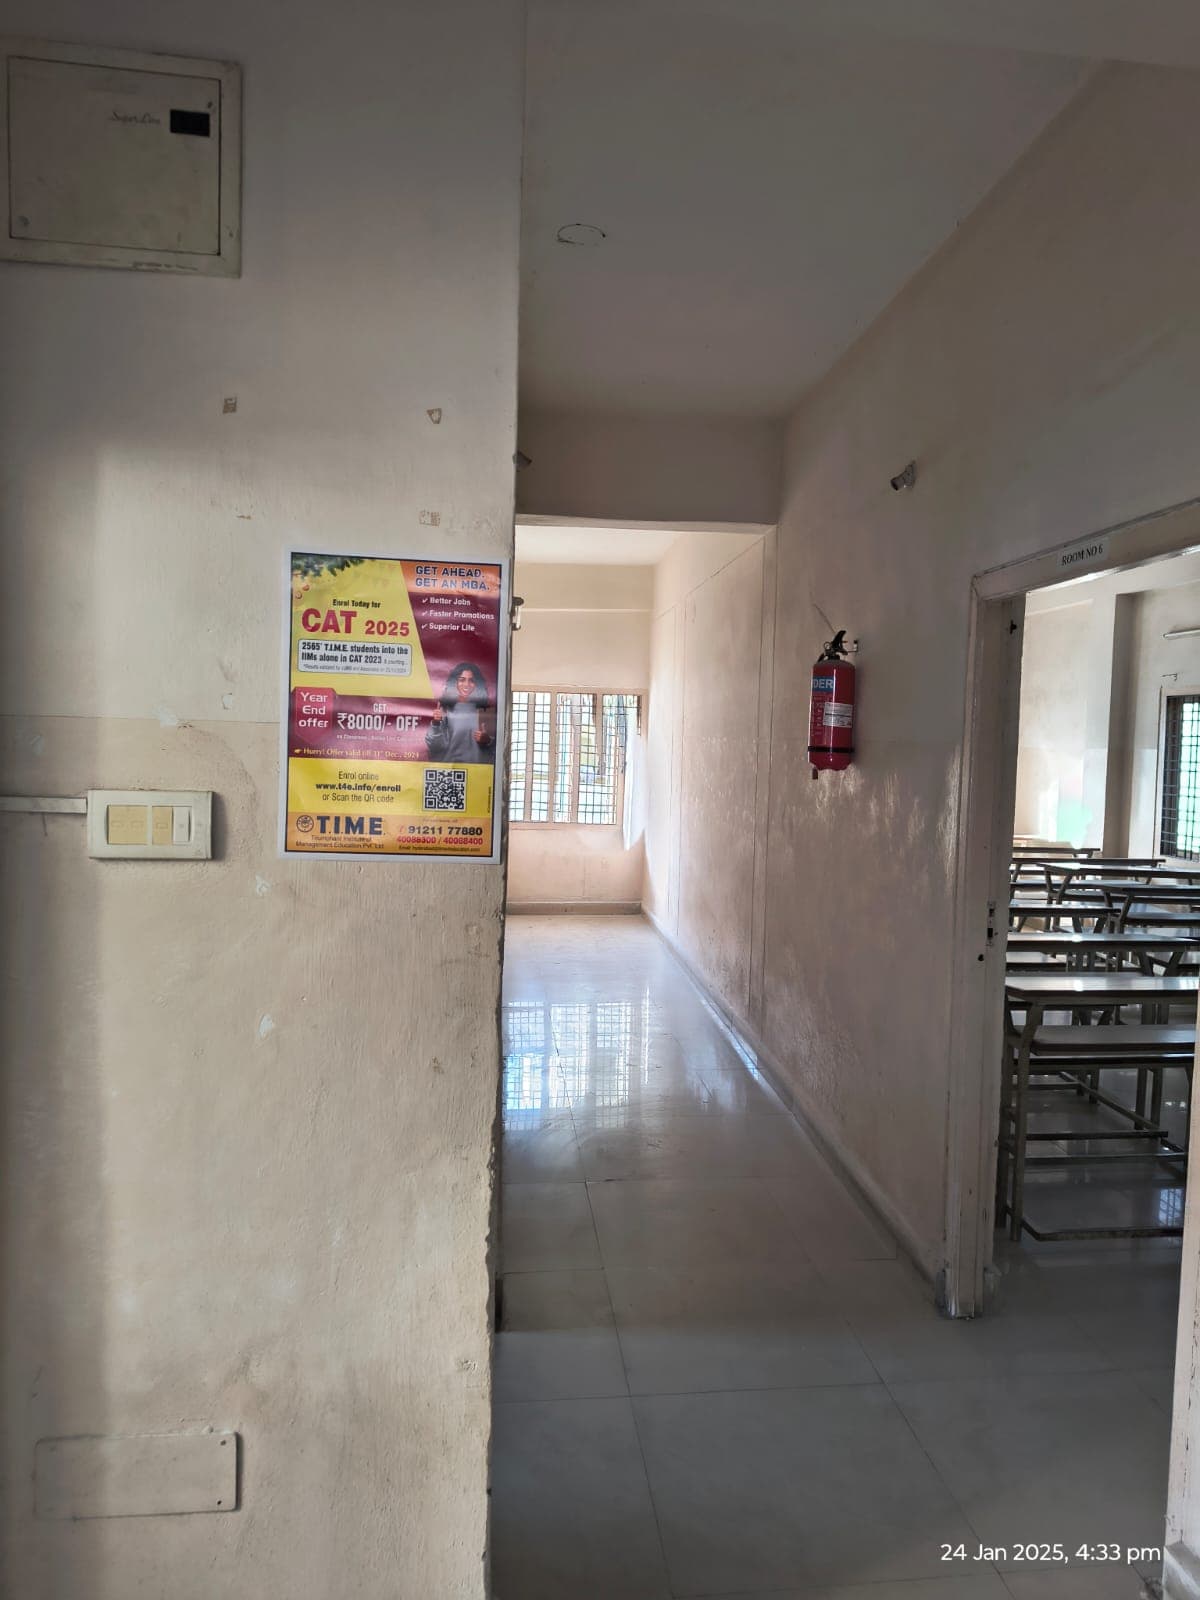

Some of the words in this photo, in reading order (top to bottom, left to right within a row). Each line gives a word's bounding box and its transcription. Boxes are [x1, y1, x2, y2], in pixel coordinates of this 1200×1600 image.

[1061, 549, 1084, 566] ROOM
[1098, 543, 1103, 554] 6
[416, 565, 437, 575] GET
[442, 567, 485, 578] AHEAD.
[415, 578, 437, 587] GET
[441, 579, 457, 588] AN
[461, 580, 490, 591] MBA.
[332, 599, 349, 607] Enrol
[352, 600, 370, 609] Today
[429, 597, 452, 605] Better
[453, 598, 471, 606] Jobs
[453, 611, 494, 620] Promotions
[301, 608, 357, 634] CAT
[365, 620, 410, 637] 2025
[429, 622, 460, 631] Superior
[350, 644, 380, 653] students
[381, 645, 396, 654] into
[397, 646, 409, 655] the
[301, 651, 317, 661] IIMs
[319, 653, 339, 662] alone
[340, 654, 347, 663] in
[349, 654, 362, 664] CAT
[364, 655, 382, 664] 2023
[813, 678, 834, 689] DER
[300, 692, 328, 702] Year
[302, 705, 326, 715] End
[373, 703, 387, 713] GET
[298, 718, 328, 728] offer
[337, 712, 392, 732] ₹8000/-
[396, 715, 419, 731] OFF
[338, 770, 356, 780] Enrol
[358, 771, 379, 780] online
[322, 793, 330, 801] or
[331, 793, 350, 801] Scan
[351, 793, 361, 801] the
[364, 794, 375, 802] QR
[377, 795, 394, 803] code
[316, 815, 386, 835] T.I.M.E.
[408, 825, 442, 835] 91211
[448, 826, 483, 836] 77880
